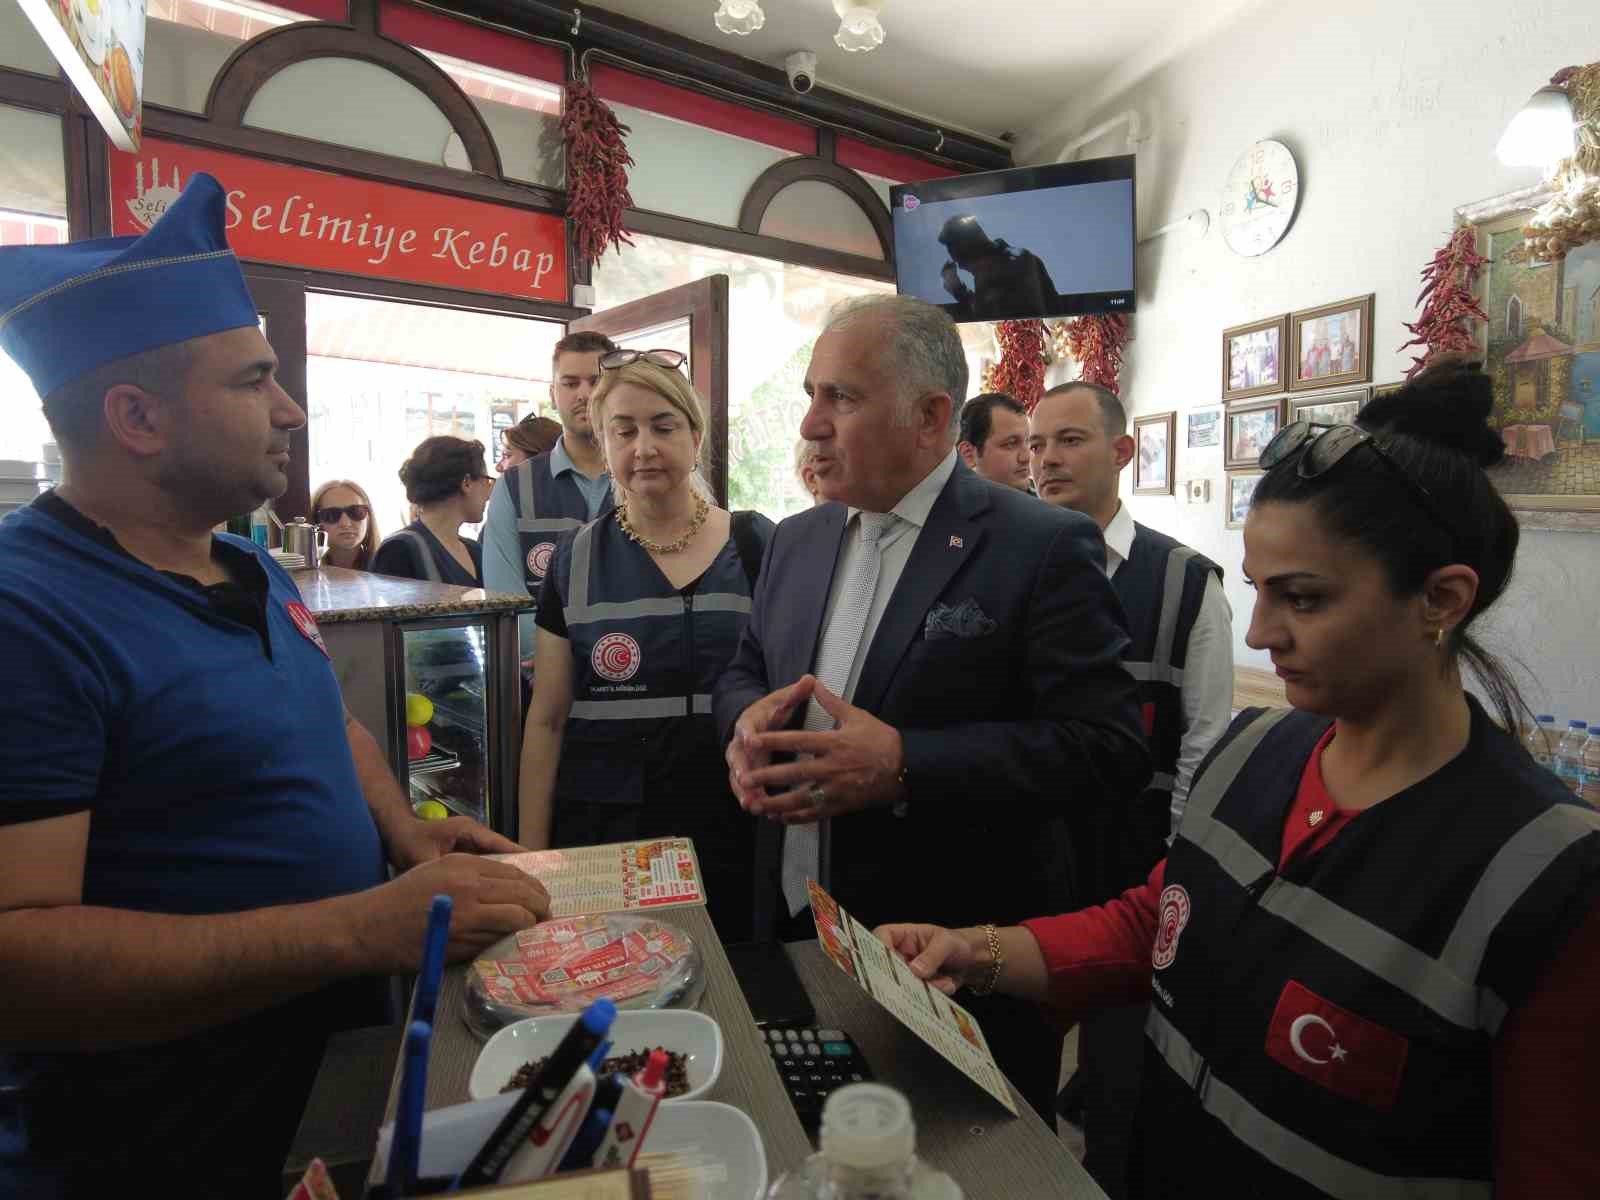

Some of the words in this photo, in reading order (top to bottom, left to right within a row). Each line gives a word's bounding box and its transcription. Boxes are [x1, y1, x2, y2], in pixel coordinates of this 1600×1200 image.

[134, 198, 170, 217] Seli
[225, 190, 417, 264] Selimiye
[432, 227, 553, 289] Kebap
